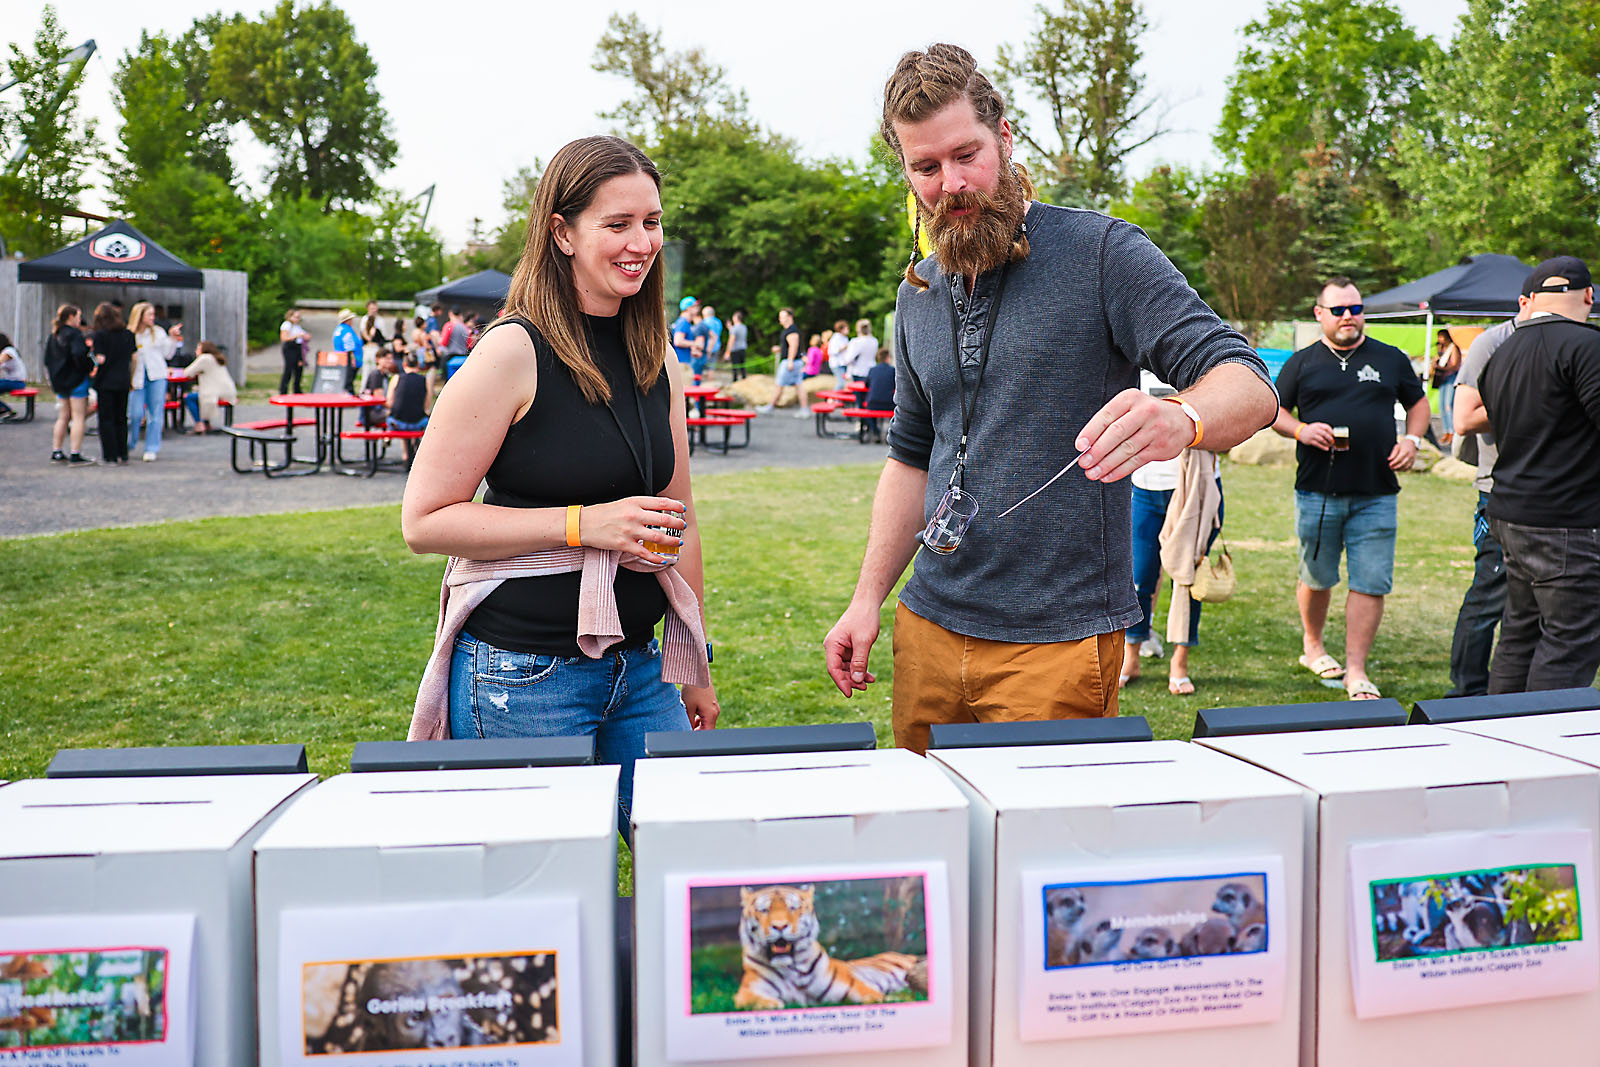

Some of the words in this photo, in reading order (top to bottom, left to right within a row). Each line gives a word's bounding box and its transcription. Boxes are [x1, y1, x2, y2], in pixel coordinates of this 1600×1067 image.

[70, 267, 92, 278] EVIL
[1110, 911, 1207, 928] Memberships
[1049, 992, 1073, 1000] Enter
[1110, 989, 1129, 997] One
[1174, 981, 1231, 991] Membership
[366, 996, 426, 1014] Gorilla
[427, 990, 513, 1011] Breakfast
